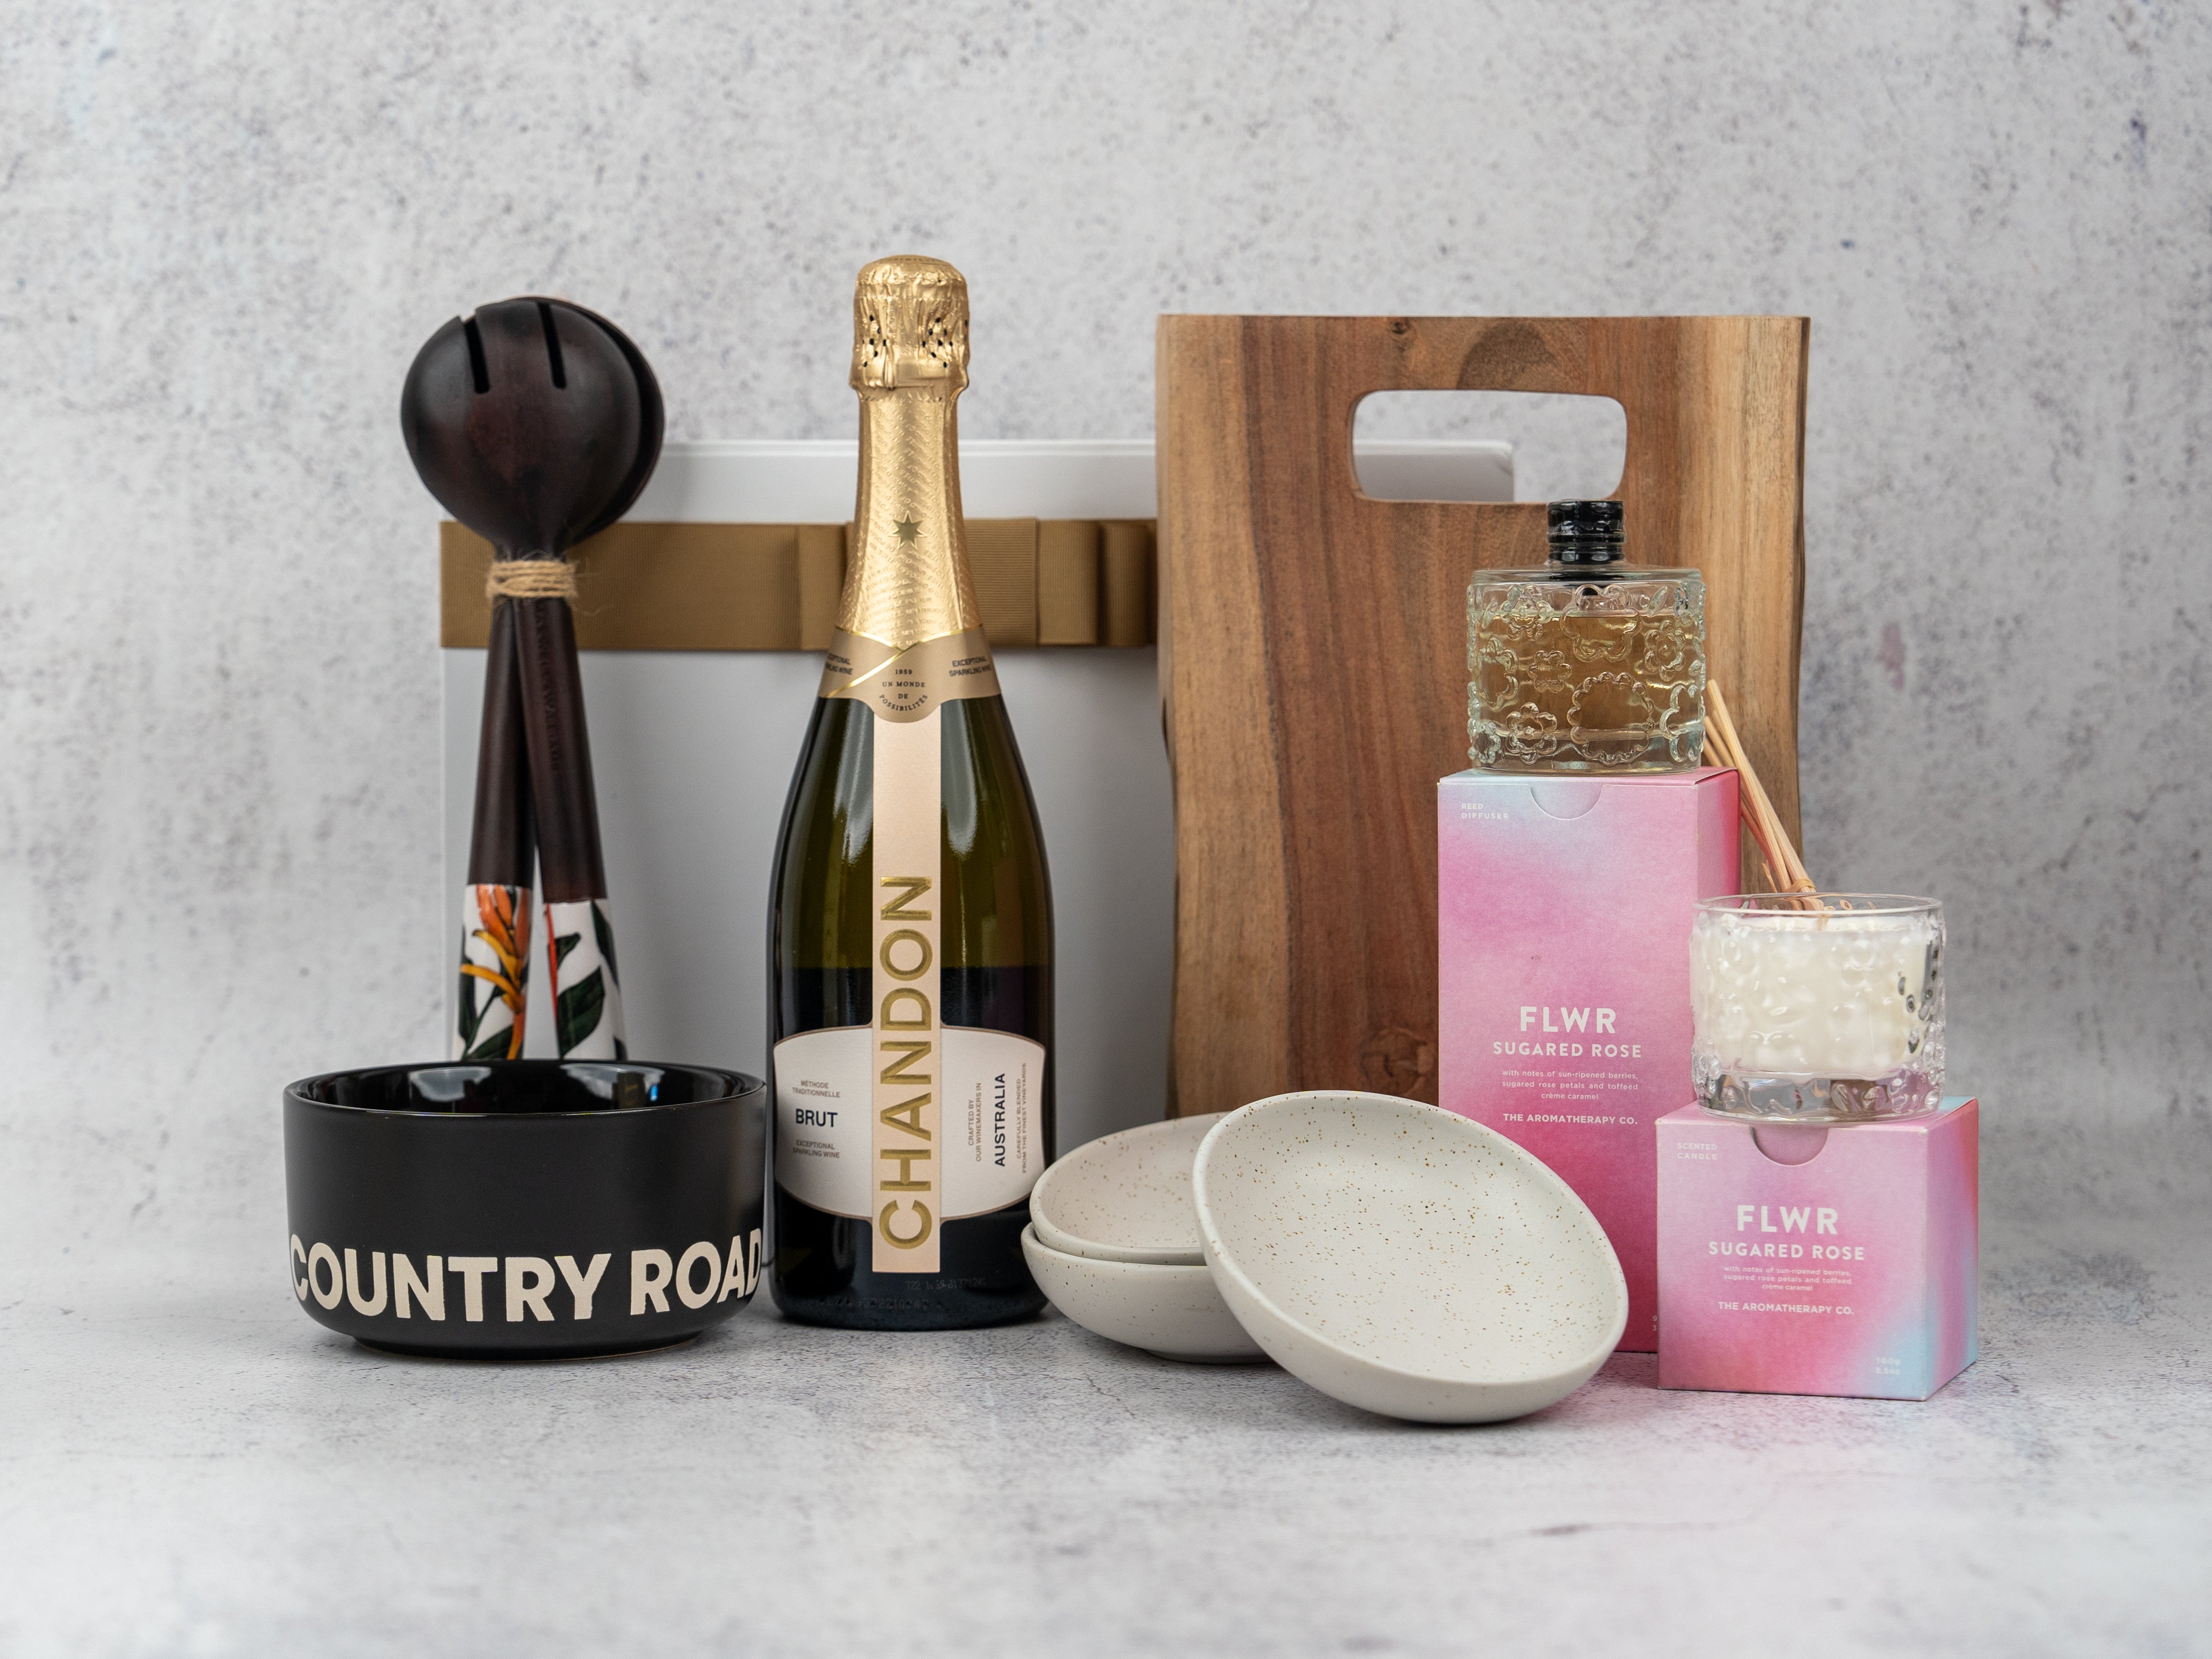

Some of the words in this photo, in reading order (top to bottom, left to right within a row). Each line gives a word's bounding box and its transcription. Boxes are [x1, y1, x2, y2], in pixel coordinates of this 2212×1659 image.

[949, 667, 982, 677] SPARKLING
[1520, 1006, 1616, 1033] FLWR
[1493, 1041, 1583, 1056] SUGARED
[1592, 1043, 1641, 1058] ROSE
[879, 877, 932, 1249] CHANDON
[801, 1080, 829, 1089] METHODE
[975, 1082, 982, 1091] IN
[792, 1086, 841, 1098] TRADITIONNELLE
[968, 1099, 974, 1109] BY
[796, 1108, 838, 1127] BRUT
[995, 1073, 1006, 1167] AUSTRALIA
[1503, 1113, 1524, 1122] THE
[1527, 1114, 1616, 1124] AROMATHERAPY
[1619, 1117, 1638, 1125] CO.
[796, 1140, 835, 1149] EXCEPTIONAL
[793, 1147, 822, 1157] SPARKLING
[1737, 1205, 1838, 1235] FLWR
[1709, 1241, 1803, 1257] SUGARED
[1812, 1245, 1865, 1261] ROSE
[291, 1234, 611, 1322] COUNTRY
[630, 1228, 762, 1315] ROAD
[1718, 1302, 1739, 1310] THE
[1742, 1303, 1832, 1313] AROMATHERAPY
[1835, 1306, 1854, 1315] CO.
